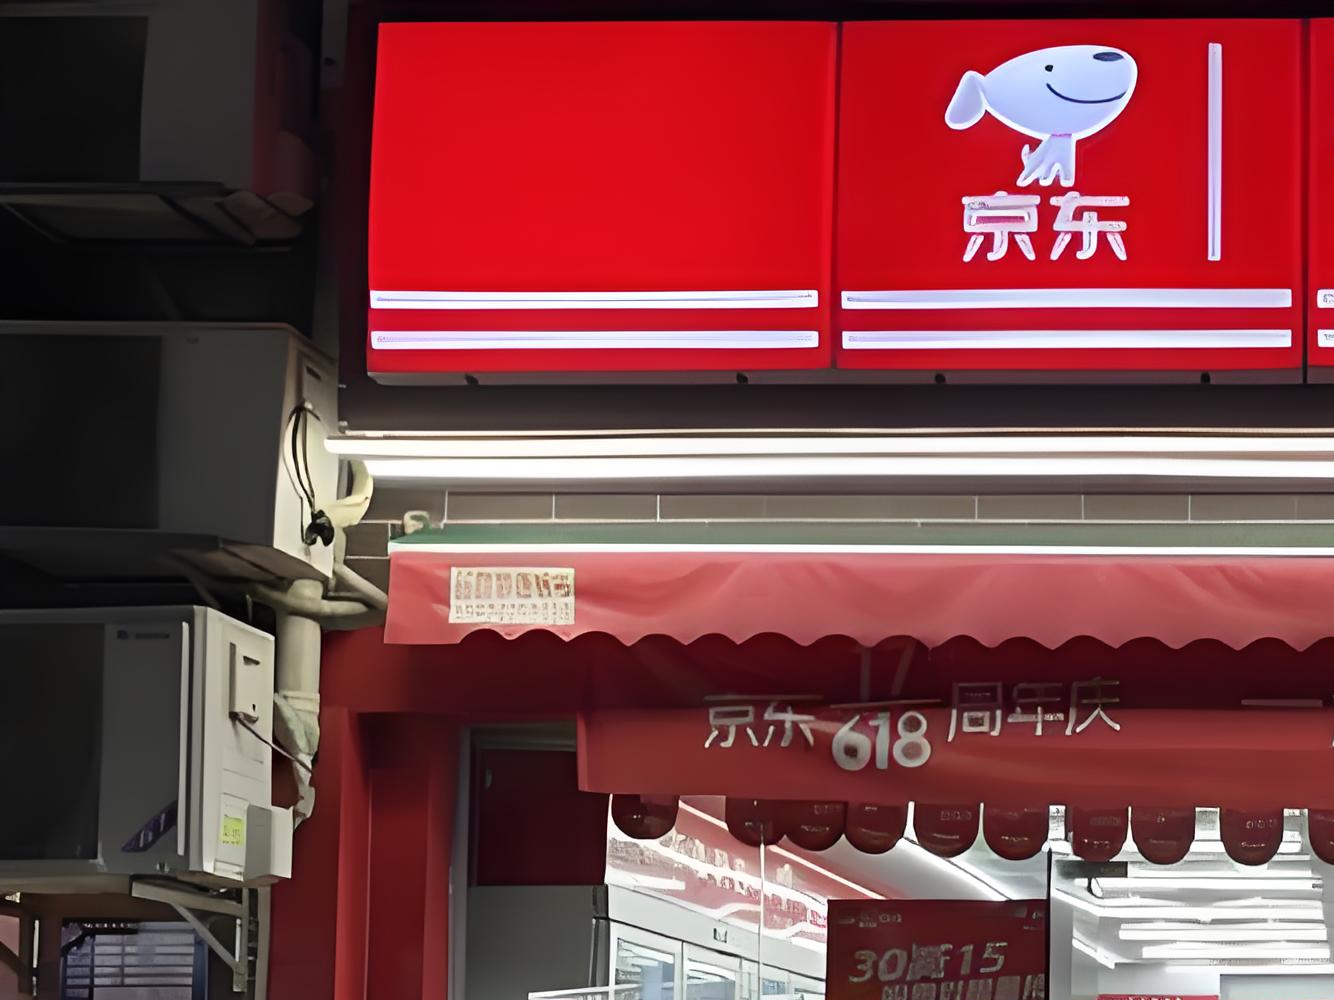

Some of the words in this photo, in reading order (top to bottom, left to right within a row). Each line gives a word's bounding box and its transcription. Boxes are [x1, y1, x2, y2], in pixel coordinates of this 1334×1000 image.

[961, 191, 1131, 263] 京东
[704, 694, 823, 748] 京东
[947, 677, 1122, 743] 周年庆
[831, 710, 932, 772] 618
